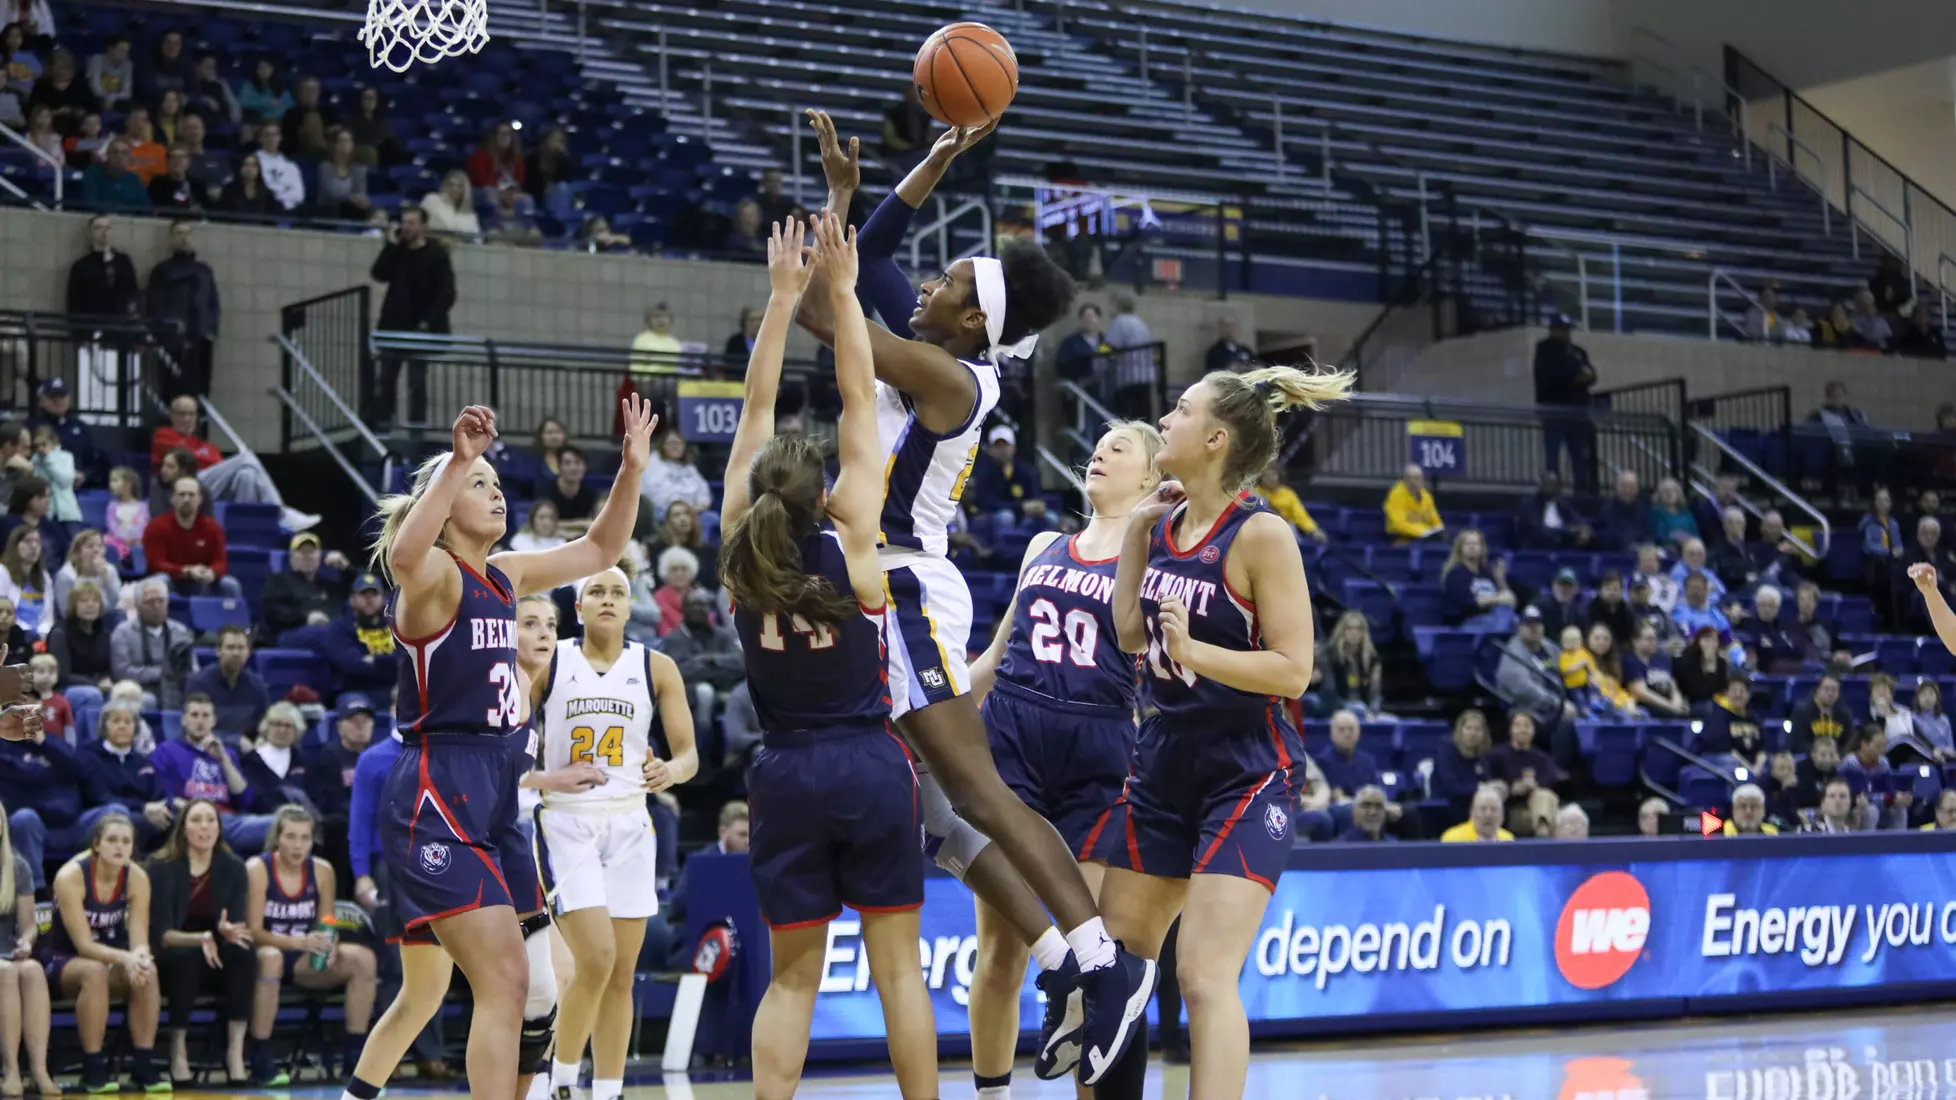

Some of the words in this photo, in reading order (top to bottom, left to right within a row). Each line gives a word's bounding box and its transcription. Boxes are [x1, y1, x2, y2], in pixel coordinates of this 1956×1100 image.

[694, 403, 738, 434] 103
[1420, 440, 1457, 469] 104
[1020, 564, 1115, 605] BELMON
[1139, 567, 1217, 617] ELMONT
[1029, 597, 1099, 668] 20
[920, 668, 945, 687] MU
[565, 697, 635, 721] MARQUETTE
[570, 725, 625, 767] 24
[1256, 903, 1445, 990] depend
[1451, 918, 1511, 969] on
[1571, 906, 1651, 954] we
[1702, 893, 1857, 967] Energy
[1861, 901, 1933, 963] you
